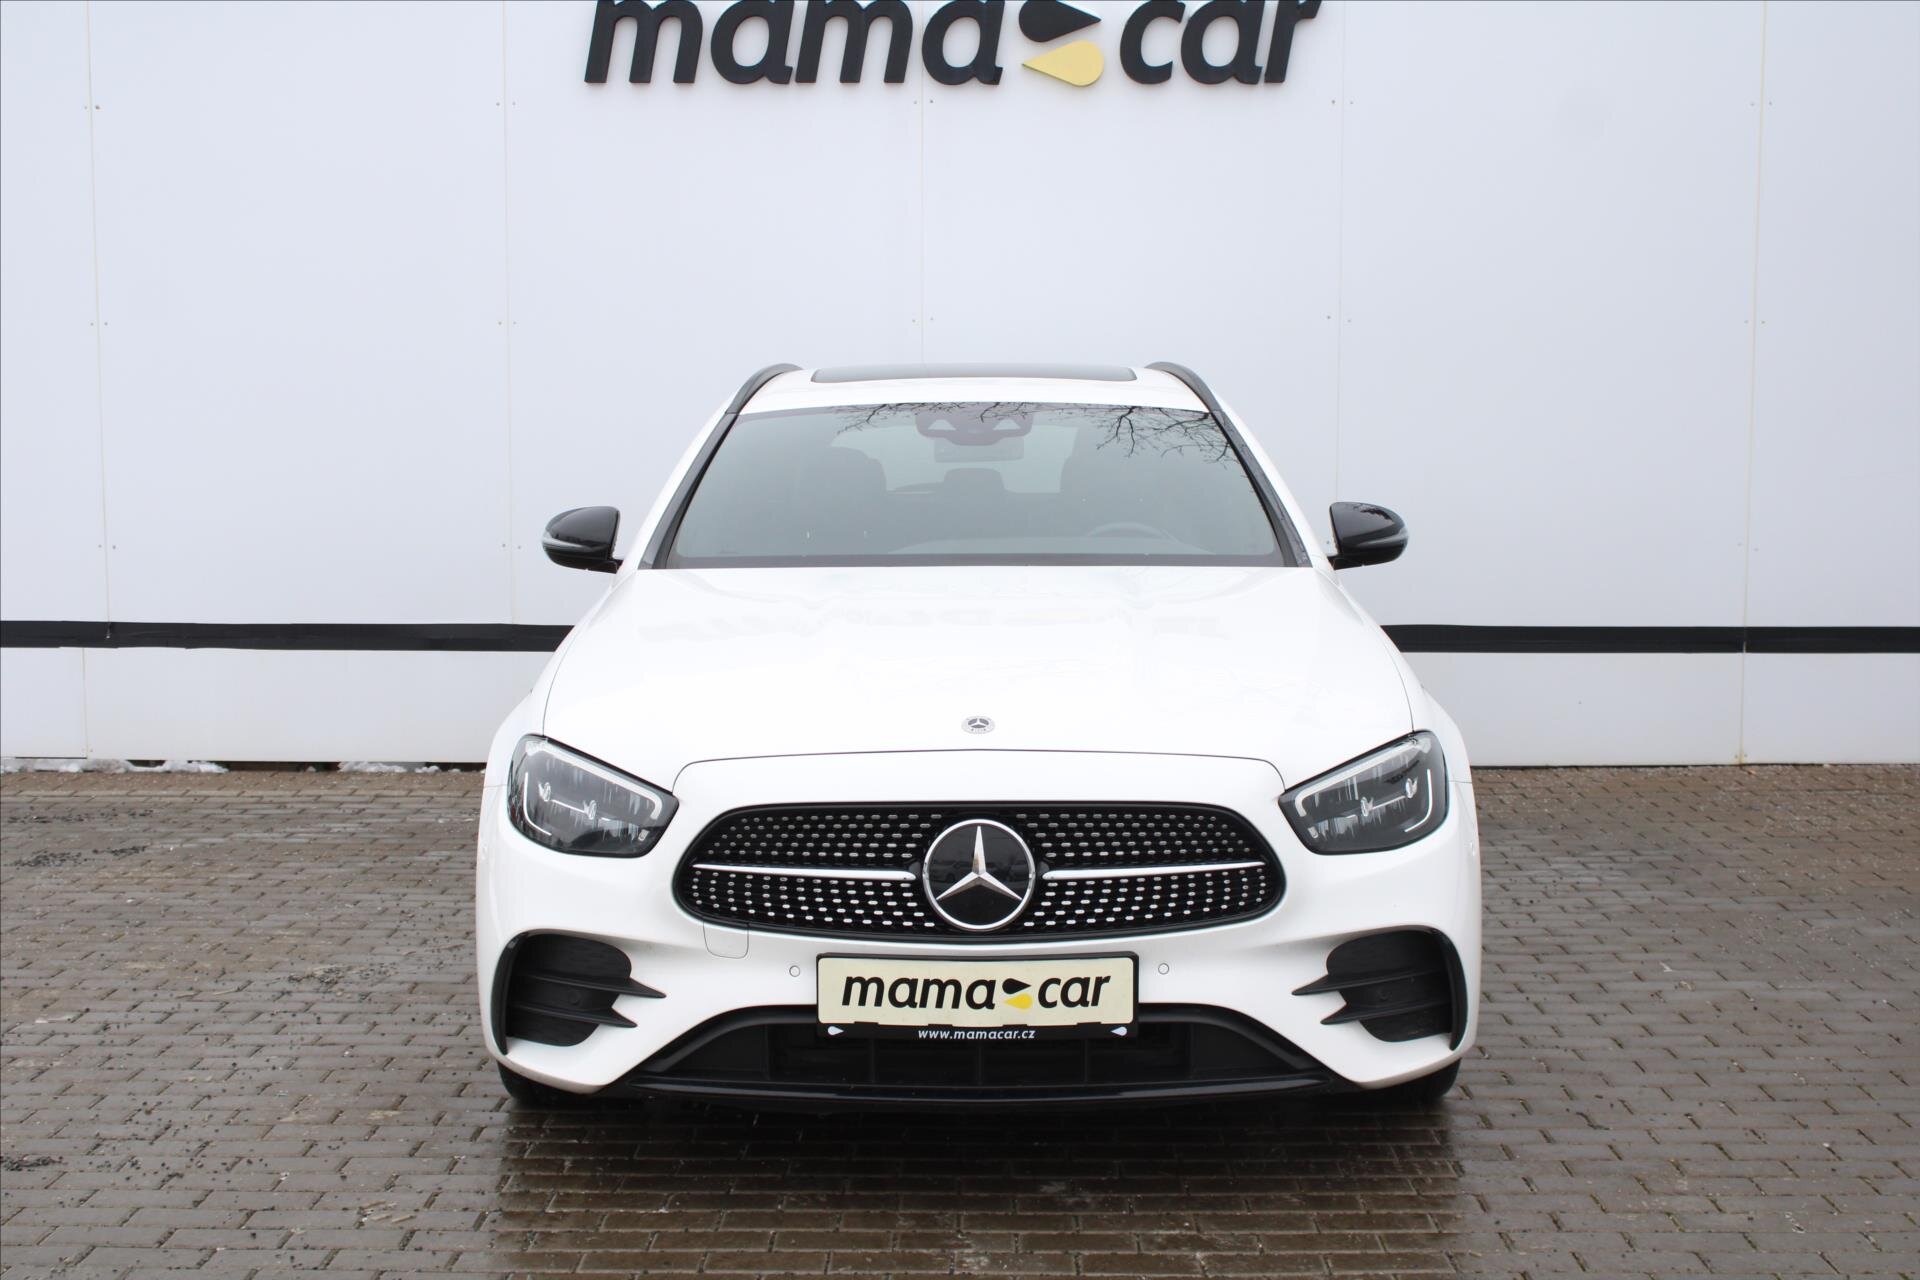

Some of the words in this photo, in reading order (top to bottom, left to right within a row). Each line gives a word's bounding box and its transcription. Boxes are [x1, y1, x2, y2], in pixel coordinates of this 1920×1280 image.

[584, 0, 1004, 85] mama
[1119, 0, 1322, 85] car
[841, 976, 996, 1010] mama
[1038, 975, 1111, 1008] car
[917, 1028, 1036, 1040] www.mamacar.cz
